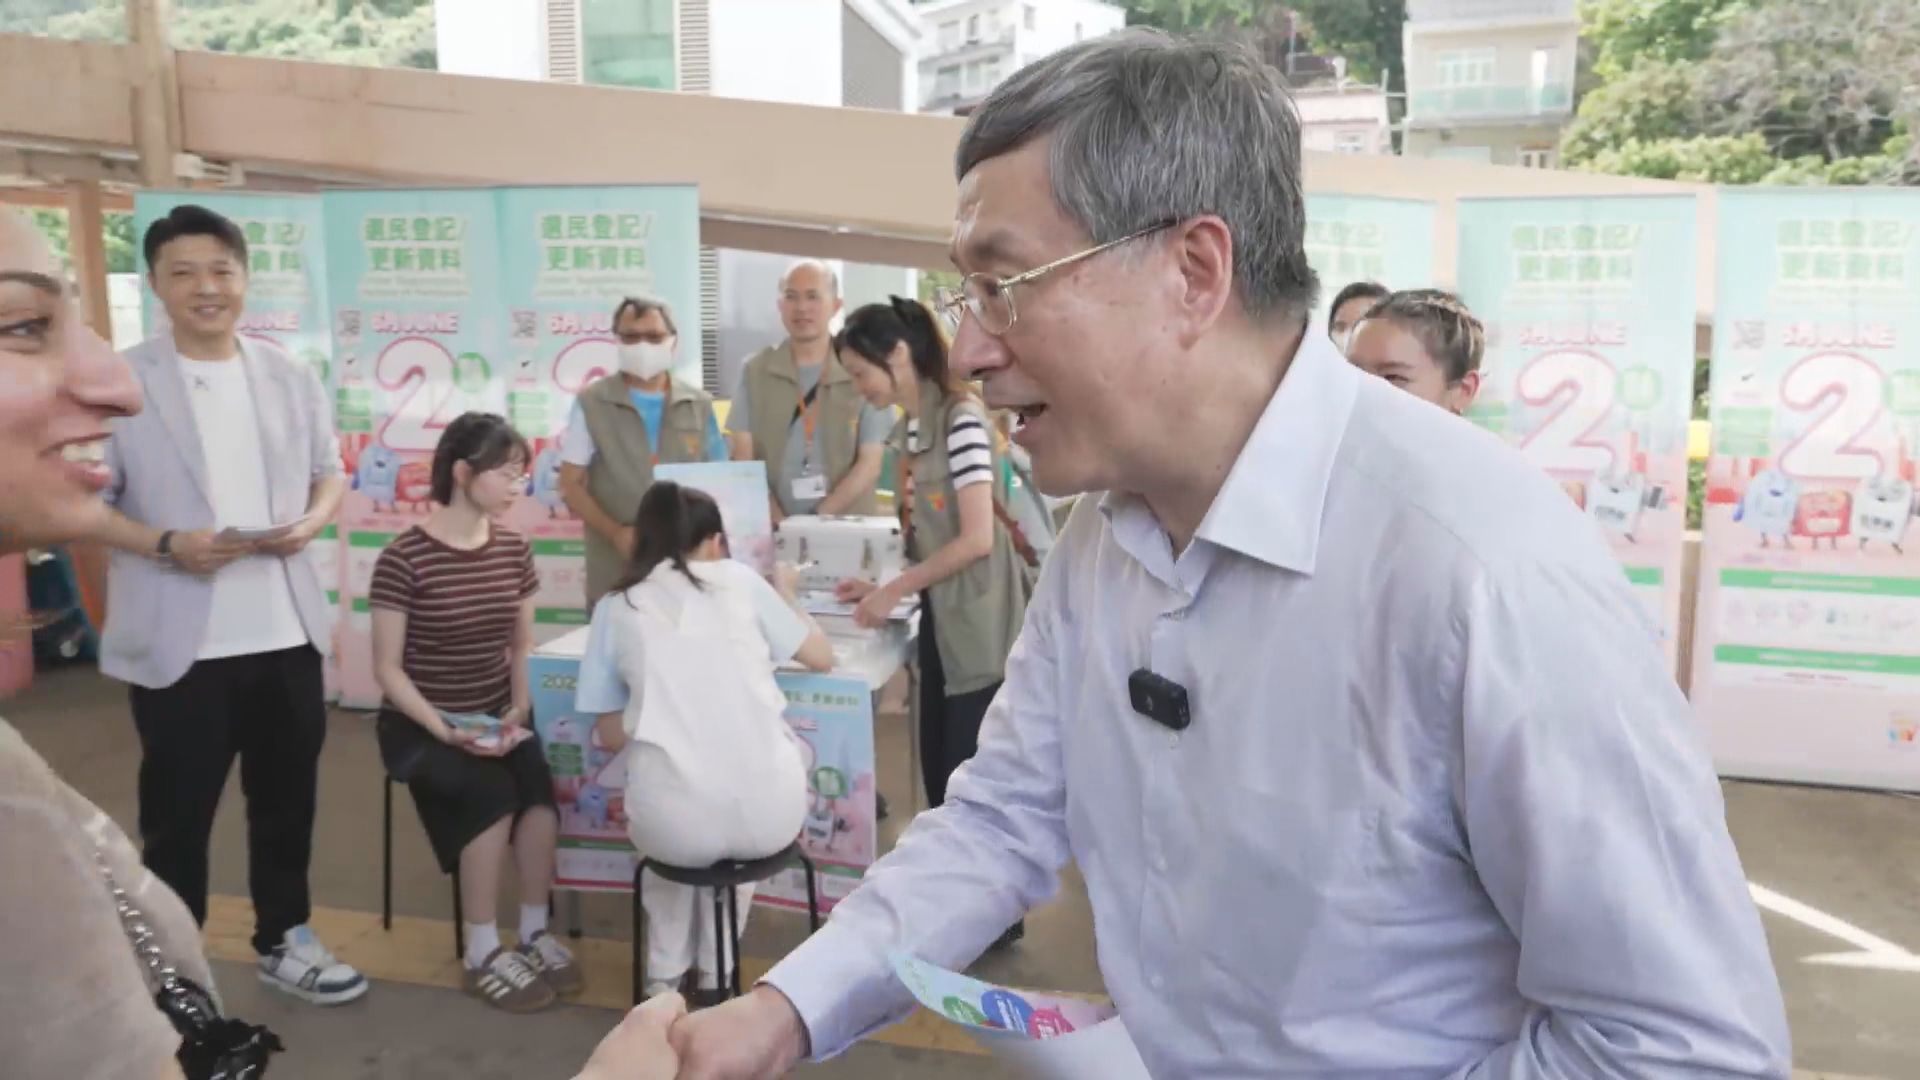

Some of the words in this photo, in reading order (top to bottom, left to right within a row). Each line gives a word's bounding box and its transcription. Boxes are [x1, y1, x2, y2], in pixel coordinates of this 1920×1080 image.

[375, 335, 458, 454] 2
[1516, 348, 1618, 476] 2
[1778, 350, 1886, 482] 2
